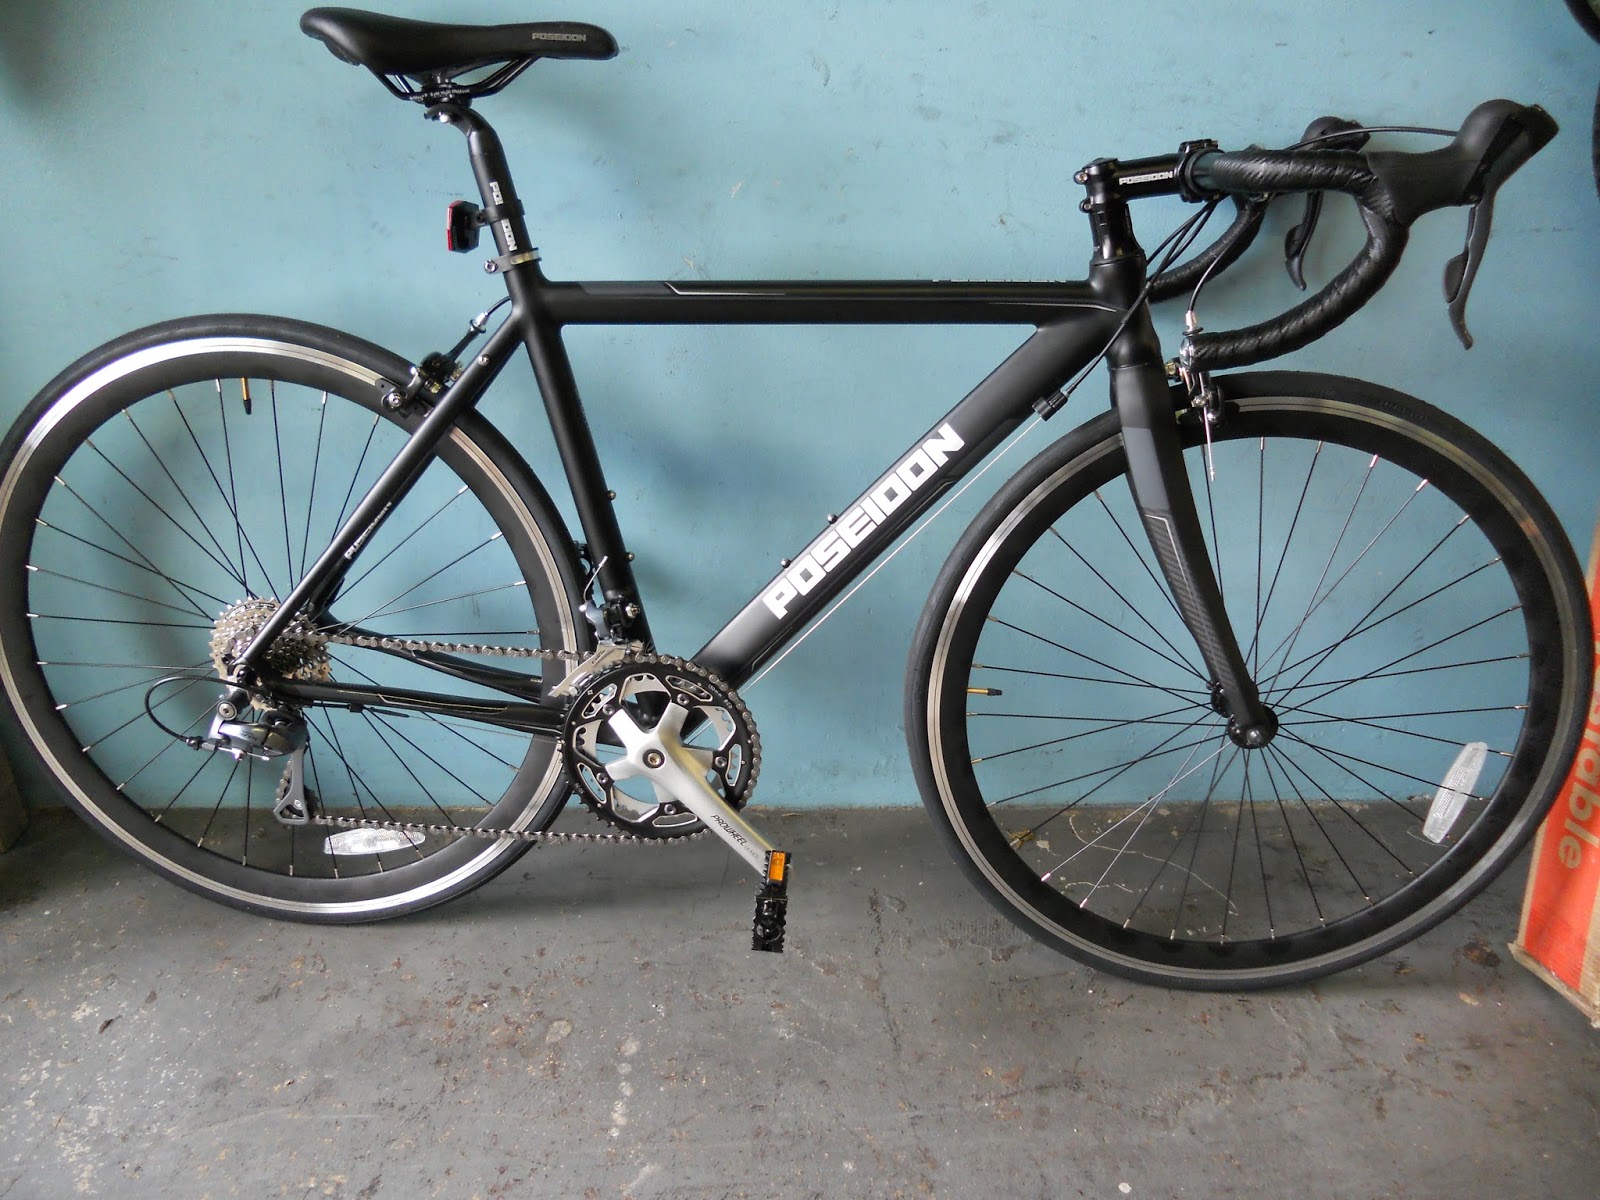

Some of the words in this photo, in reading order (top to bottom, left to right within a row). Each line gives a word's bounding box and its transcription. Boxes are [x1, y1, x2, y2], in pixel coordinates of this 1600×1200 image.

[532, 32, 587, 42] POSEIDON
[1118, 171, 1174, 186] POSEIDON
[762, 422, 965, 620] POSEIDON
[711, 814, 747, 847] PROWHEEL
